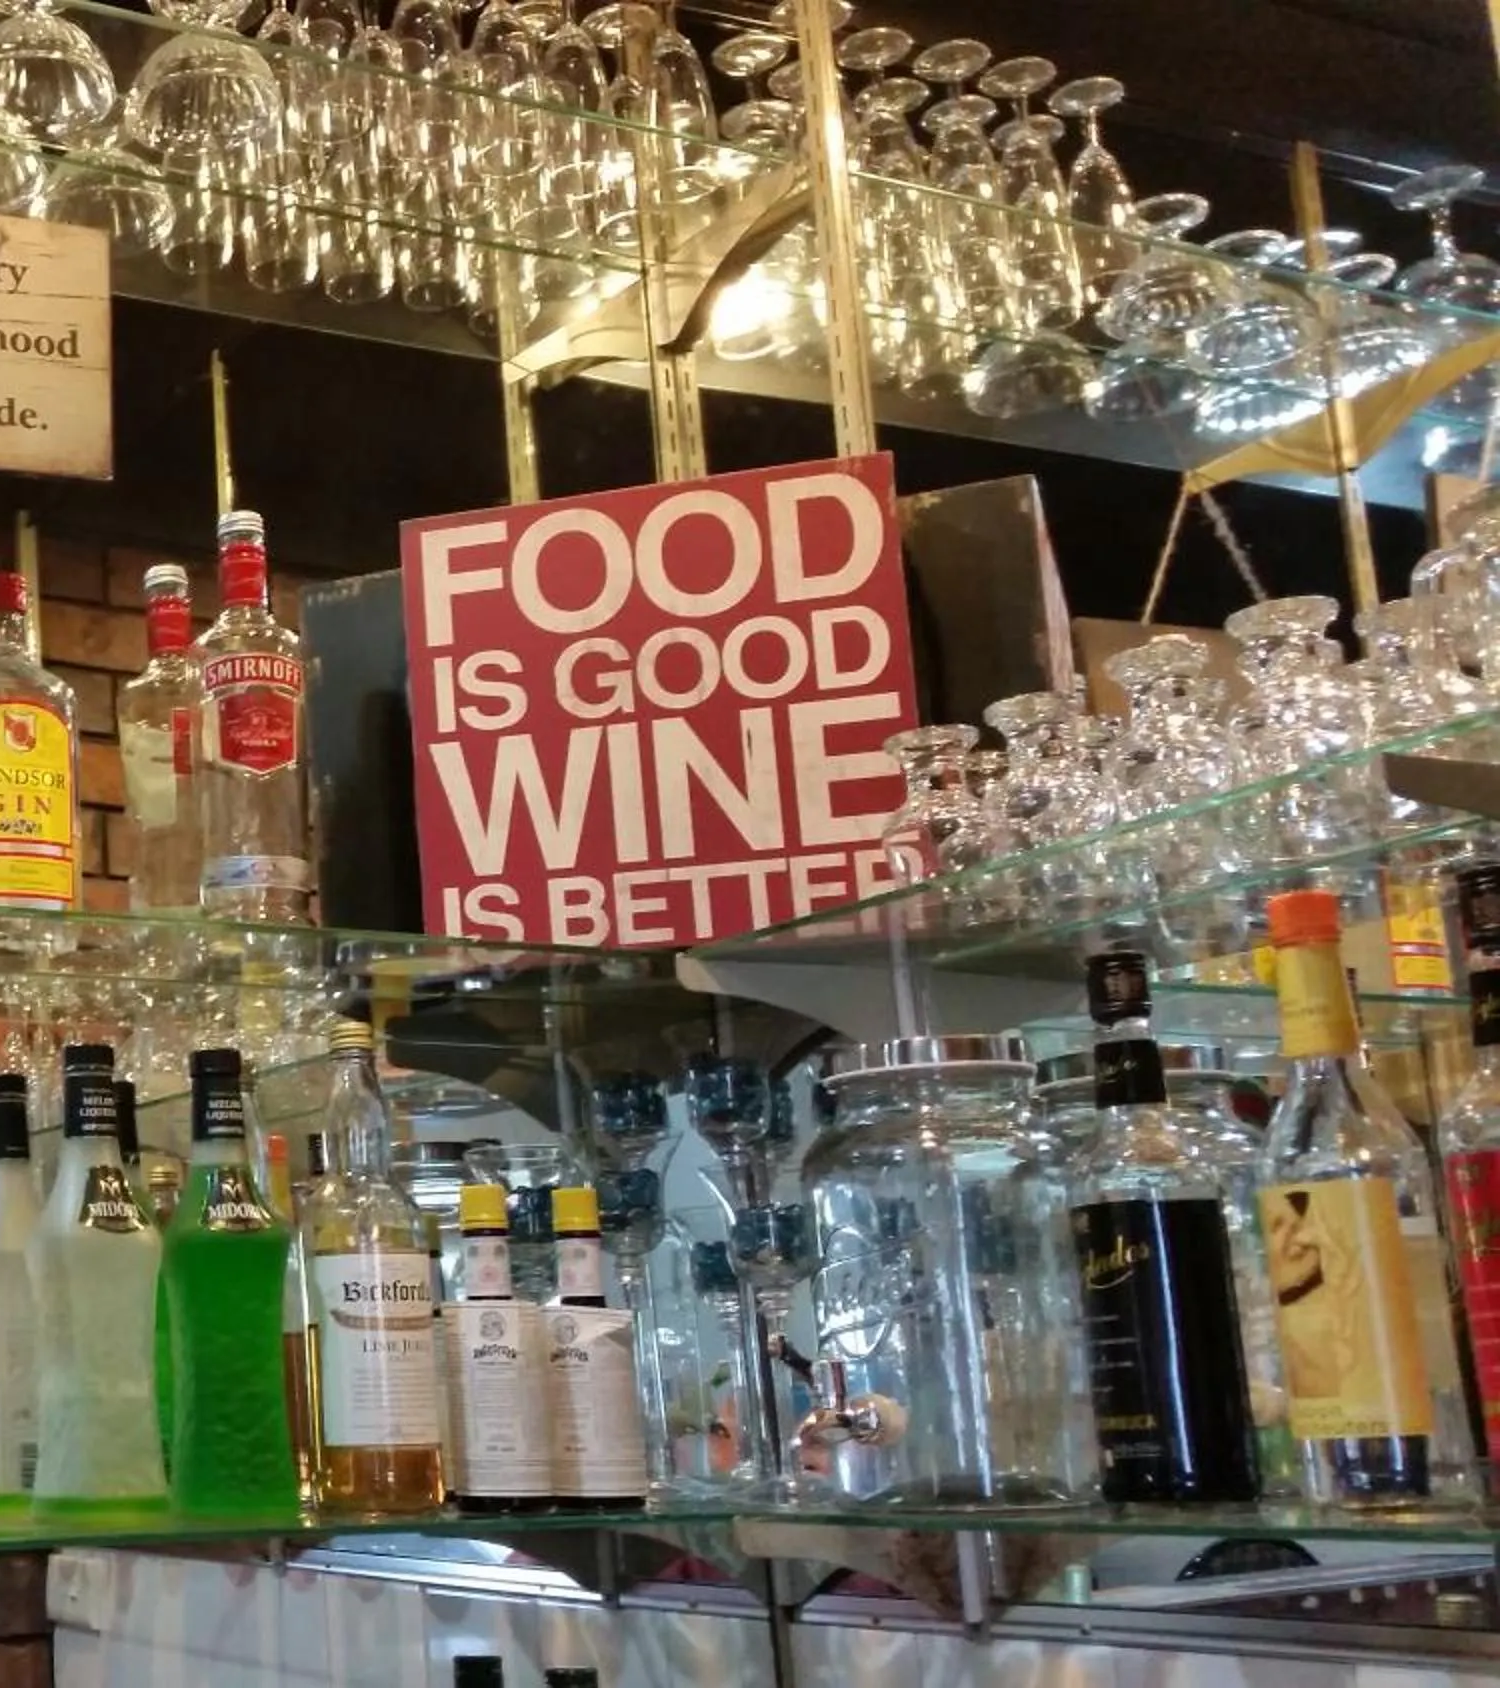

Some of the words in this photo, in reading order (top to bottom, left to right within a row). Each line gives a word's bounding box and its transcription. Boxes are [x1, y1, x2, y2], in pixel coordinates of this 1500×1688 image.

[420, 473, 885, 648] FOOD
[206, 656, 300, 688] SMIRNOFF
[433, 649, 529, 733] IS
[553, 604, 892, 720] GOOD
[427, 691, 905, 877] WINE
[442, 883, 526, 943] IS
